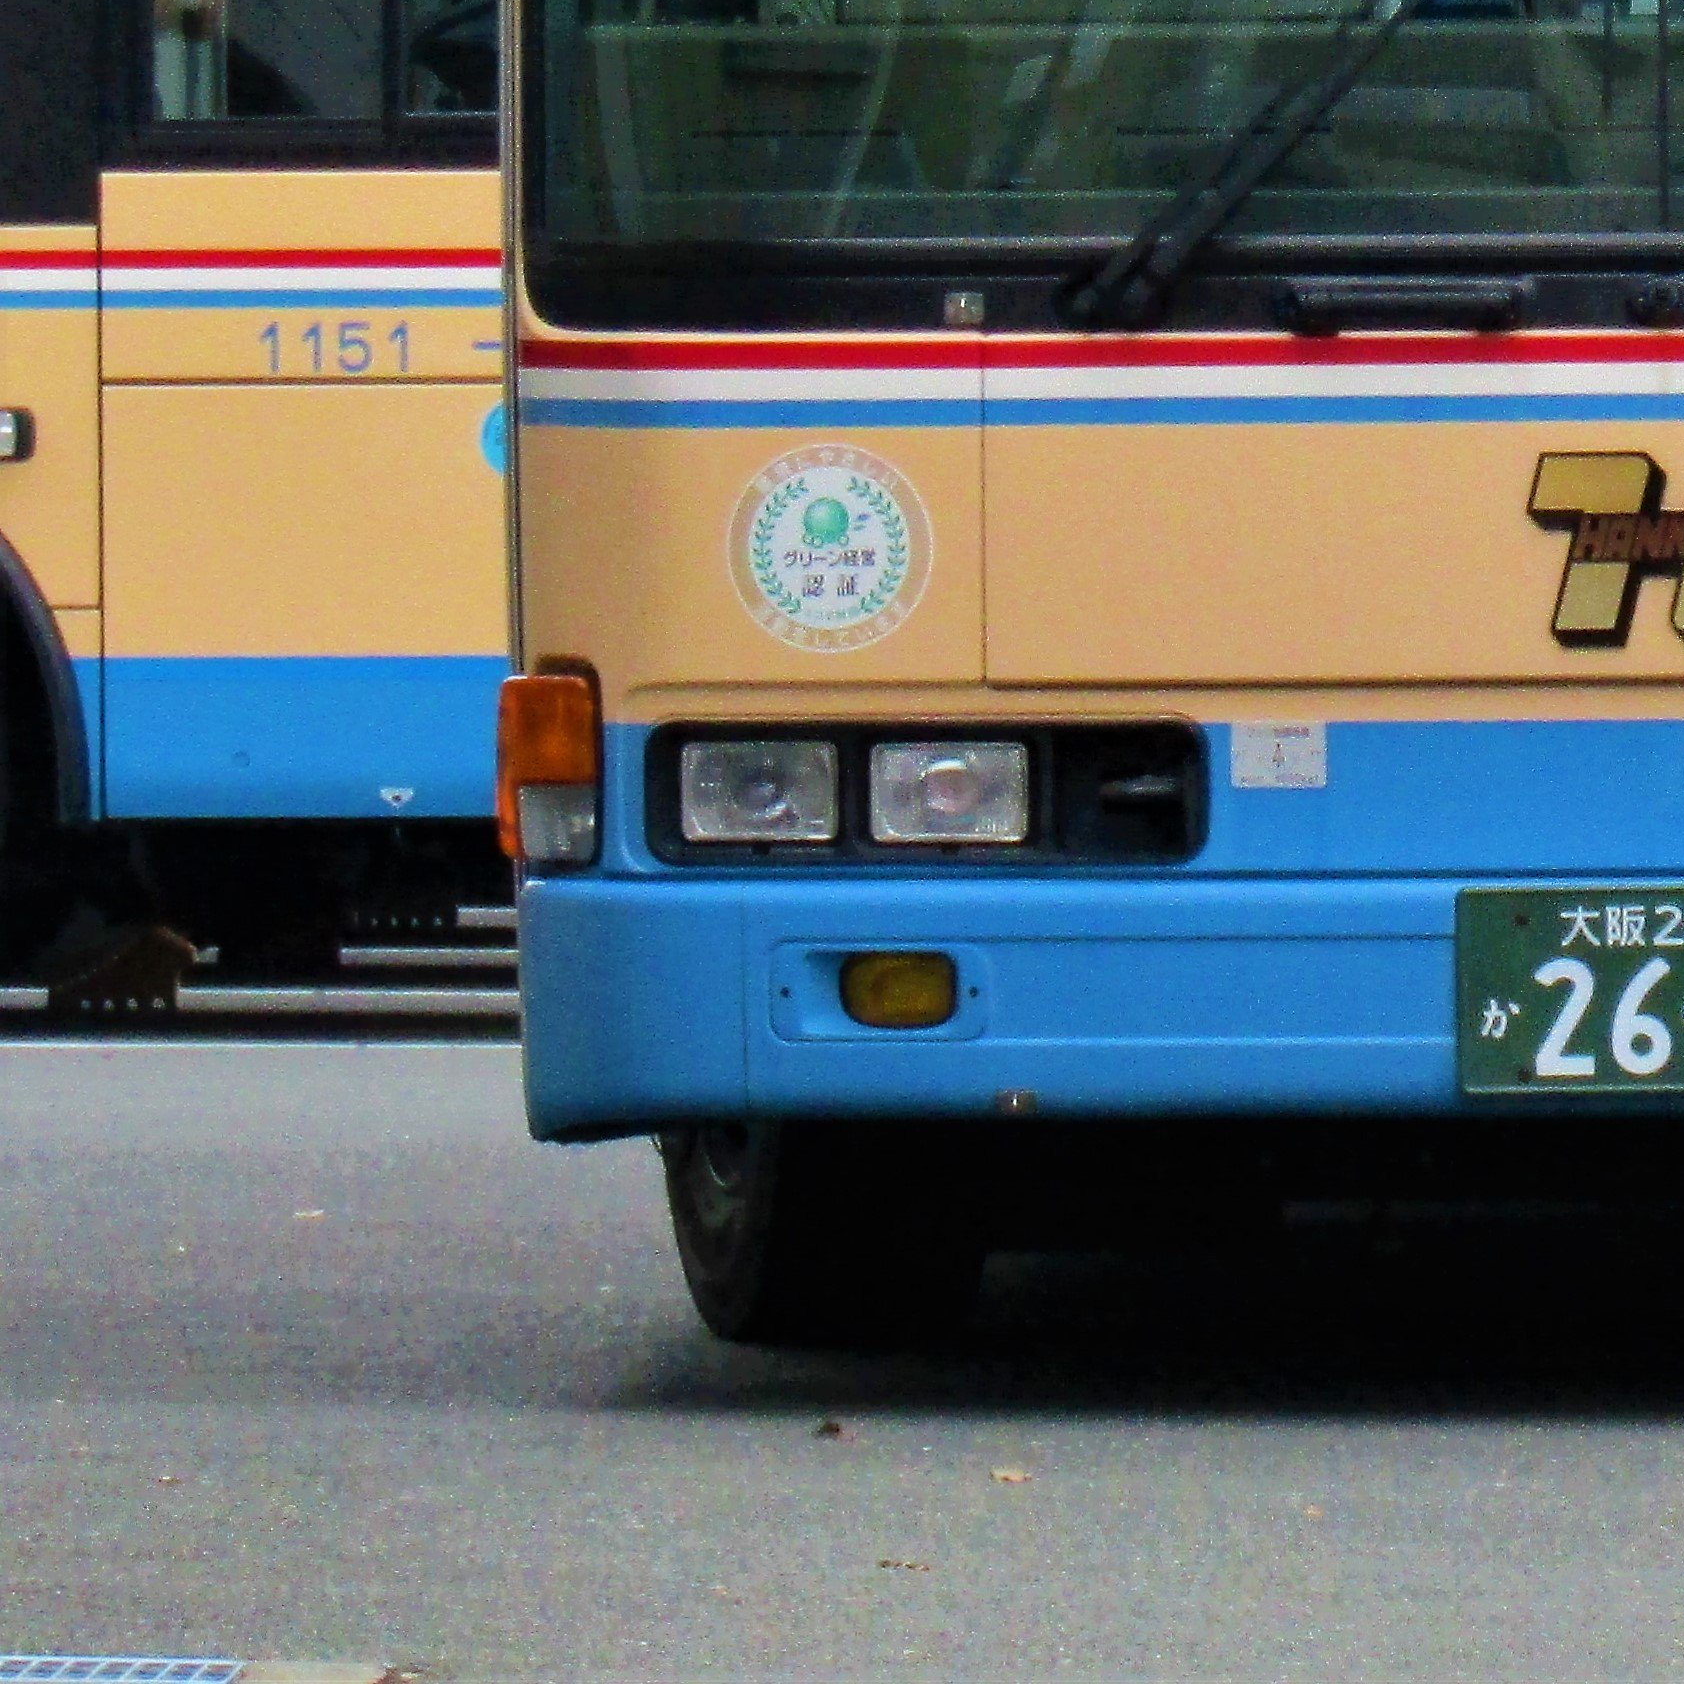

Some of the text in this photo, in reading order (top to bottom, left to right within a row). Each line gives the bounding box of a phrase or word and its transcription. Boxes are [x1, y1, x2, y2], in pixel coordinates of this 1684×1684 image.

[259, 320, 410, 373] 1151
[782, 548, 877, 568] グリーン経営
[1480, 998, 1521, 1039] か
